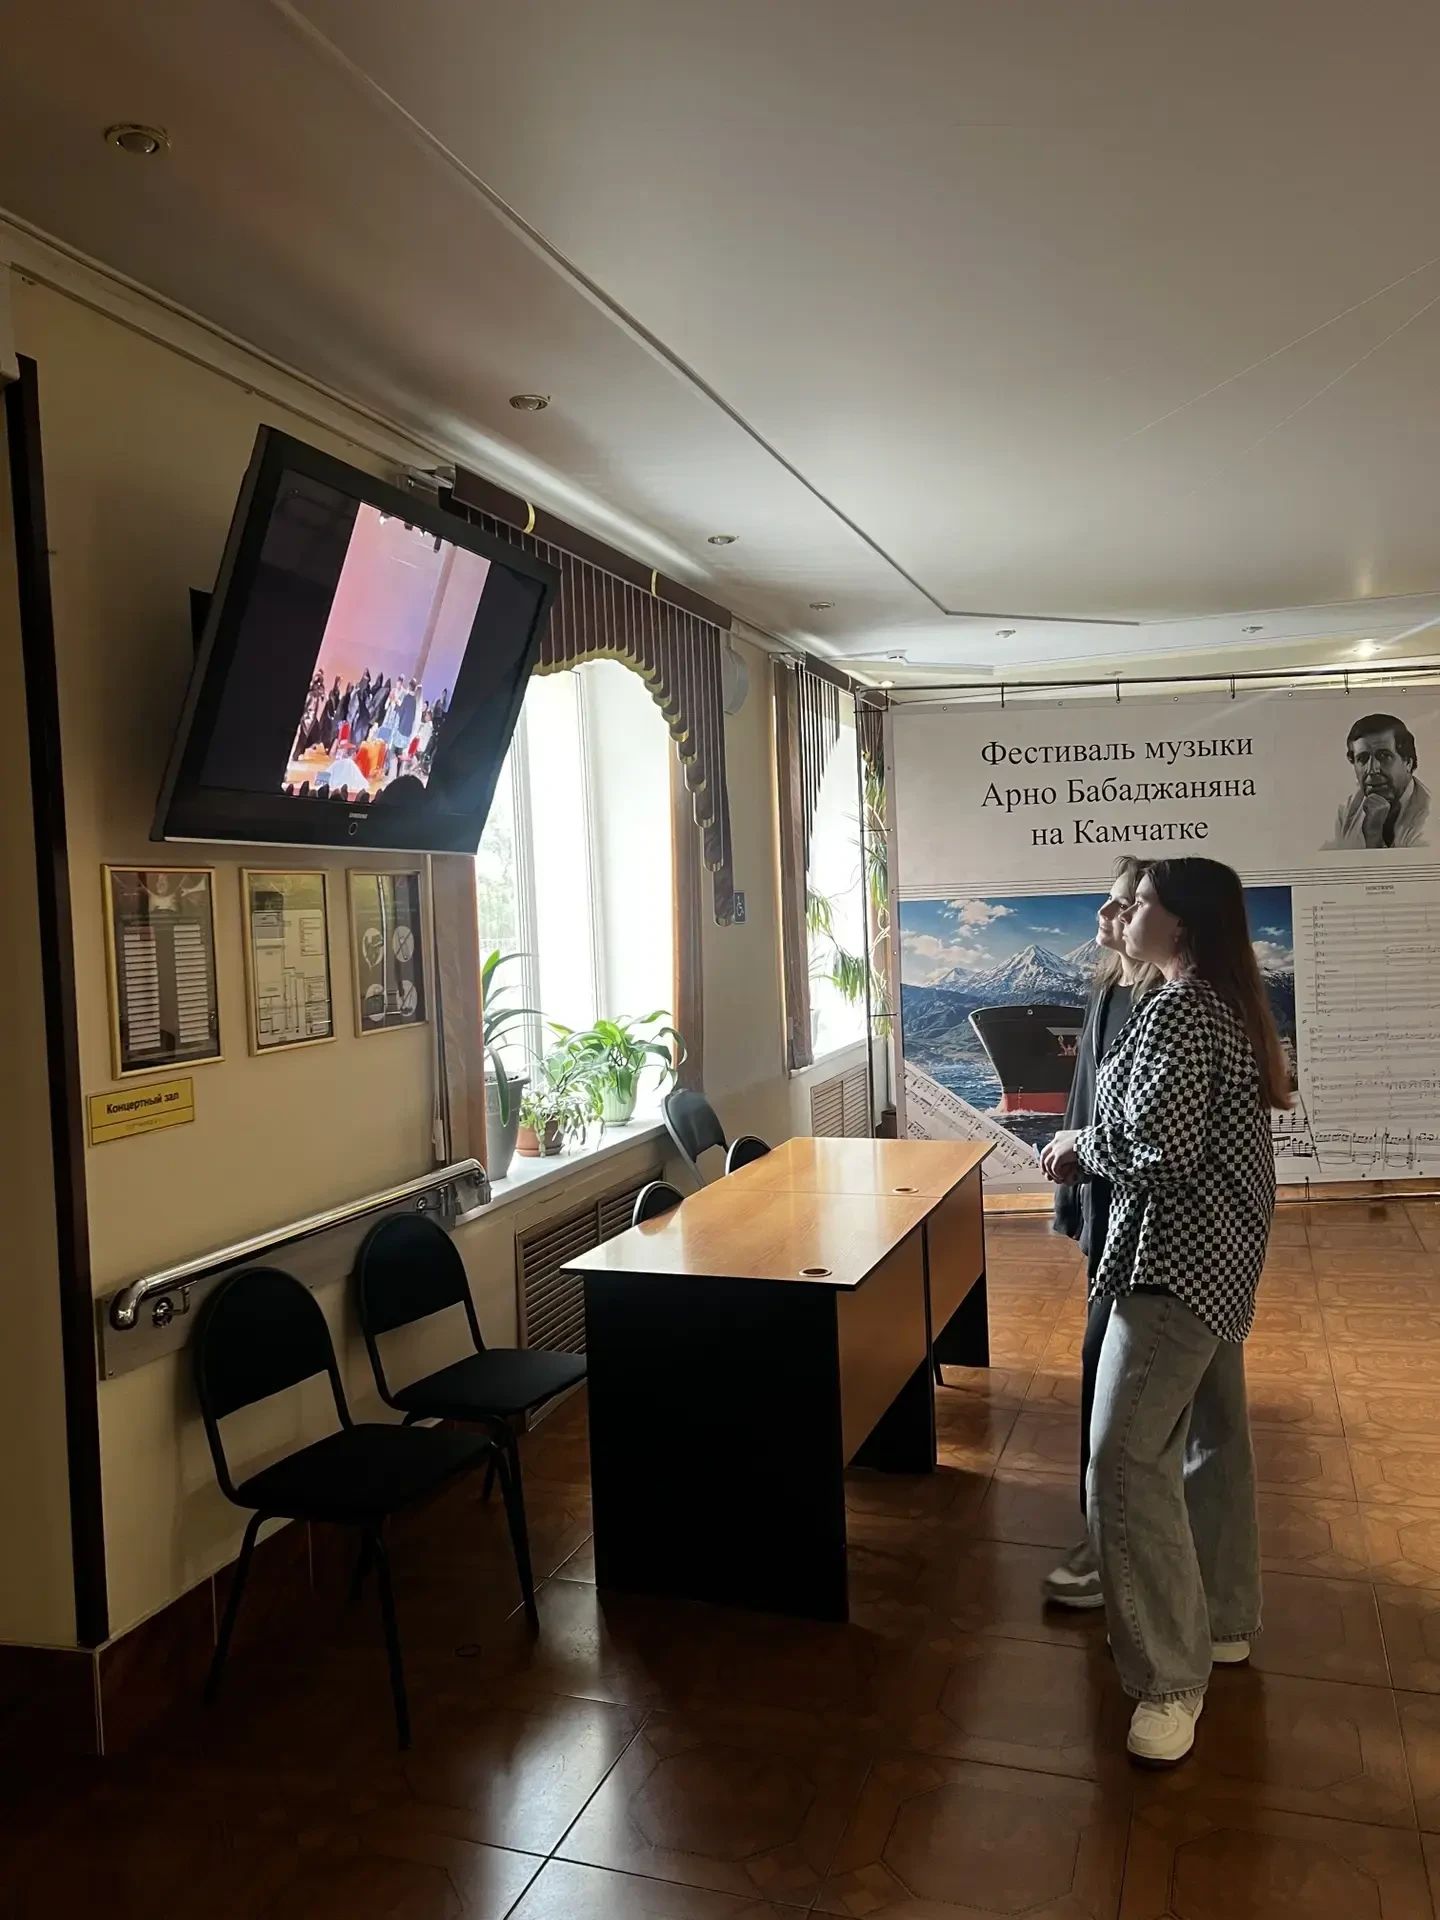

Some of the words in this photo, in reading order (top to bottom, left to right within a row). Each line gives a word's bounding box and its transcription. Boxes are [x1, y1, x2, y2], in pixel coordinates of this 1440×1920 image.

[981, 741, 1135, 765] Фестиваль
[1145, 738, 1253, 764] музыки
[981, 782, 1057, 813] Арно
[1066, 776, 1256, 803] Бабаджаняна
[1031, 827, 1064, 846] на
[1073, 820, 1209, 844] Камчатке
[106, 1094, 162, 1114] Концертный
[164, 1092, 179, 1102] зал
